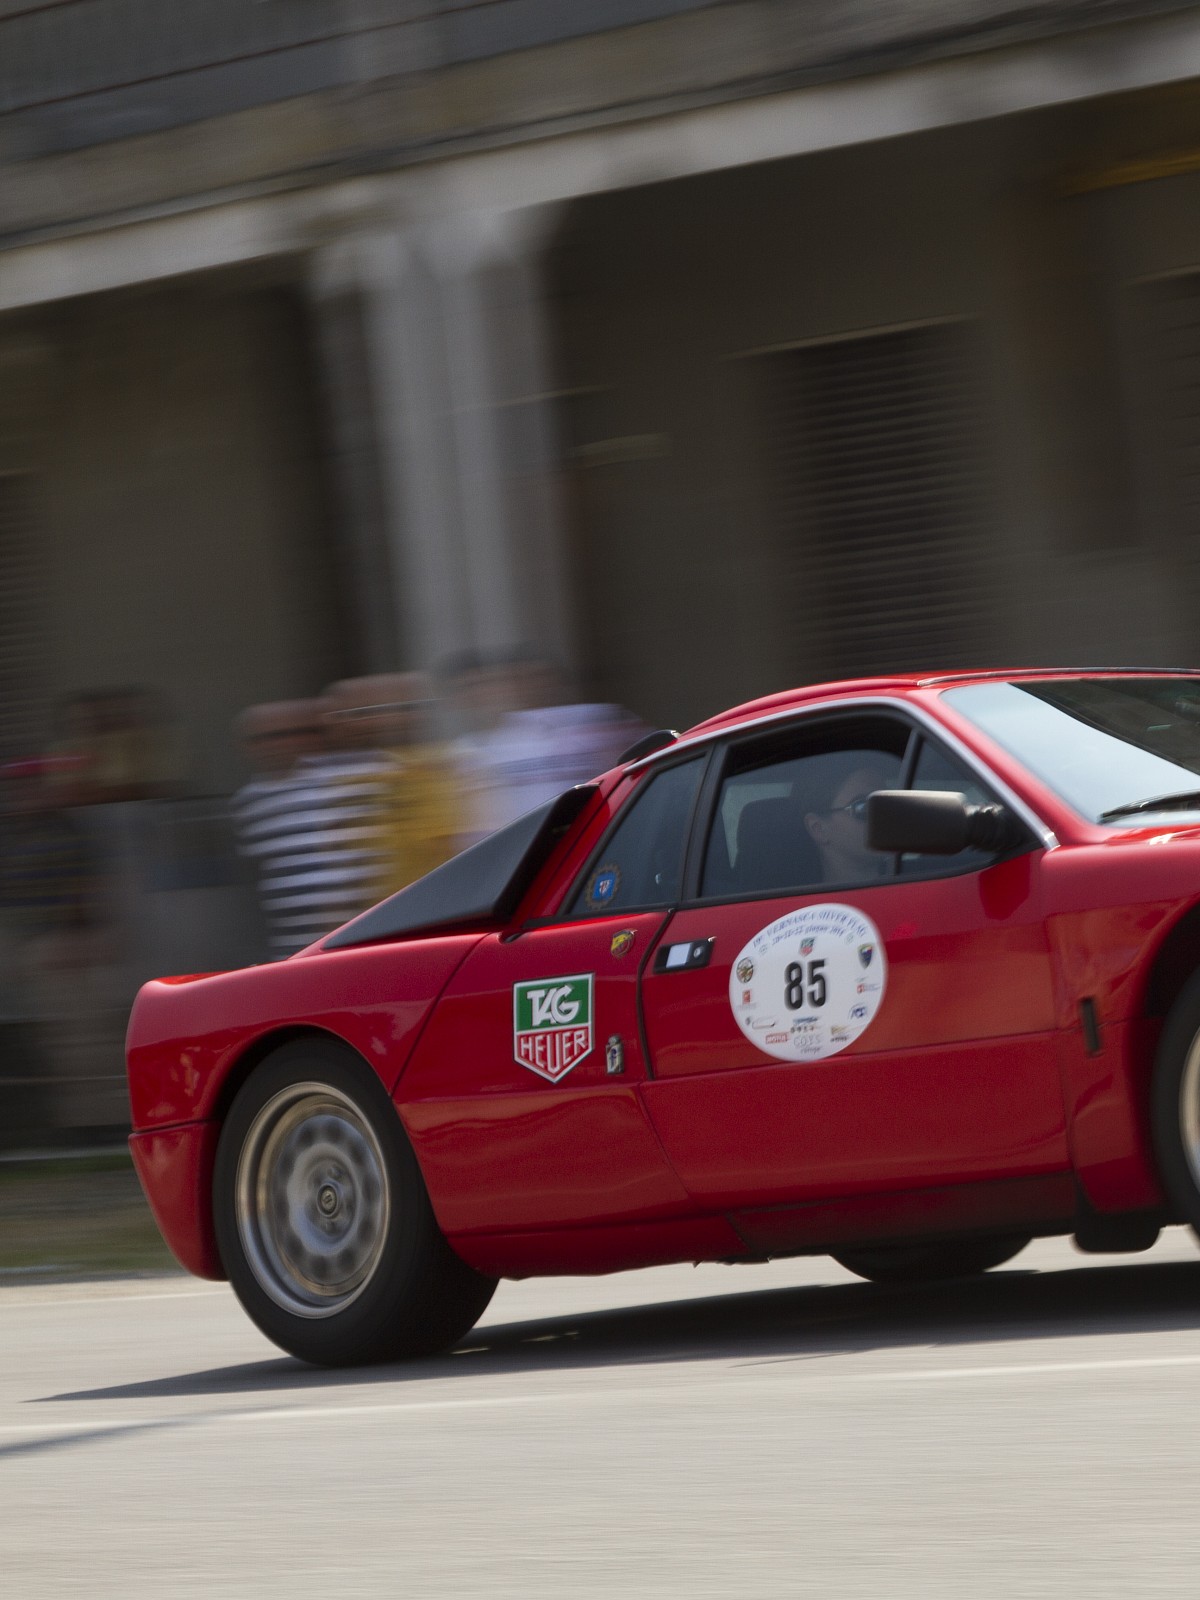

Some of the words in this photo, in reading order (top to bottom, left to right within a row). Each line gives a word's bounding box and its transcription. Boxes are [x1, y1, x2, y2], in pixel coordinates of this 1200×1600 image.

[527, 984, 580, 1027] TAG
[785, 959, 826, 1010] 85
[520, 1030, 588, 1074] HEUER
